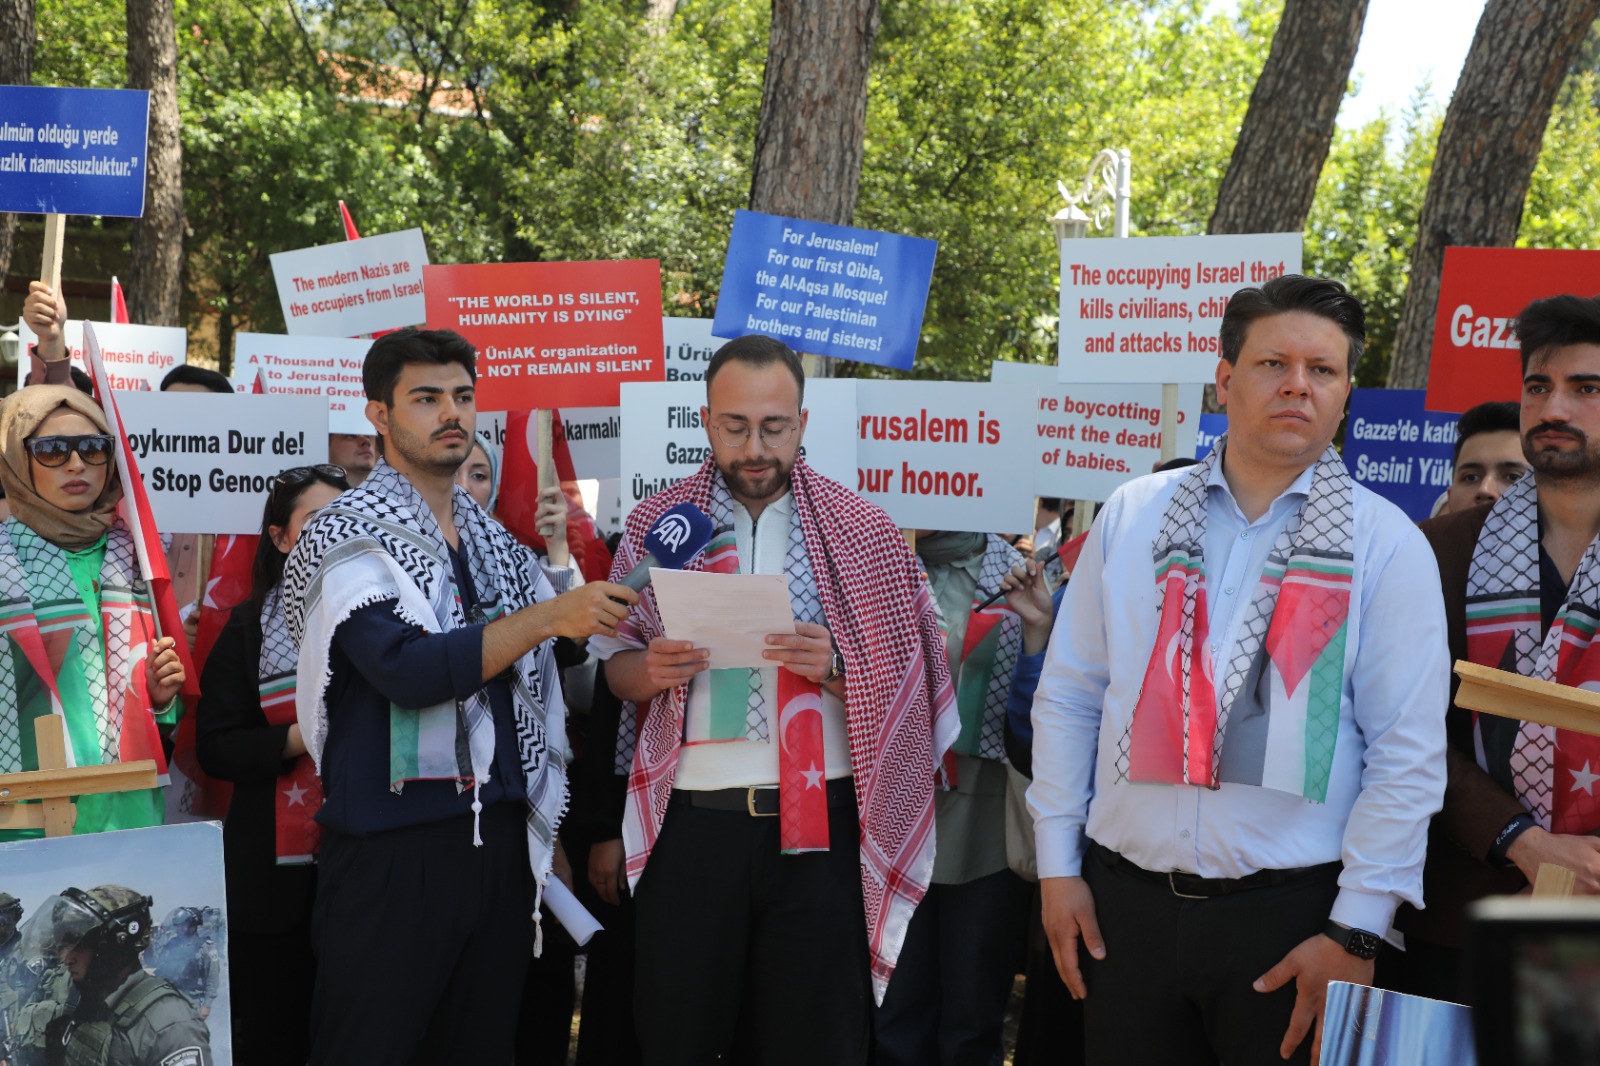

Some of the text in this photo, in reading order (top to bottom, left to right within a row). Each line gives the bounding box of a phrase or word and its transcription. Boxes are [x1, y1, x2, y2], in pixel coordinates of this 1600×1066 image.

[38, 124, 79, 149] olduğu
[82, 126, 118, 149] yerde
[0, 152, 26, 172] ızlık
[782, 228, 879, 257] For Jerusalem!
[292, 260, 410, 293] The modern Nazis are
[767, 249, 883, 285] For our first Qibla,
[1070, 260, 1285, 290] The occupying Israel that
[290, 279, 424, 317] the occupiers from Israel
[448, 291, 640, 309] "THE WORLD IS SILENT,
[756, 270, 888, 306] the Al-Aqsa Mosque!
[459, 309, 632, 326] HUMANITY IS DYING"
[756, 293, 877, 327] For our Palestinian
[1080, 298, 1114, 319] kills
[1118, 297, 1193, 323] civilians,
[747, 314, 883, 352] brothers and sisters!
[1085, 331, 1115, 353] and
[1120, 331, 1182, 353] attacks
[101, 347, 143, 364] lmesin
[147, 351, 174, 370] diye
[248, 354, 364, 369] A Thousand Voi
[485, 345, 536, 360] ÜniAK
[540, 344, 637, 360] organization
[268, 370, 283, 380] to
[487, 364, 521, 377] NOT
[527, 362, 591, 376] REMAIN
[595, 359, 652, 373] SILENT
[236, 384, 245, 392] a
[251, 383, 321, 395] ousand
[1038, 397, 1058, 411] re
[1064, 395, 1161, 426] boycotting
[857, 408, 1000, 445] rusalem is
[1037, 423, 1075, 440] vent
[1081, 425, 1110, 443] the
[127, 428, 304, 458] oykırıma Dur de!
[1042, 448, 1131, 473] of babies.
[1355, 454, 1413, 484] Sesini
[152, 466, 201, 498] Stop
[901, 461, 983, 498] honor.
[652, 520, 684, 553] AA
